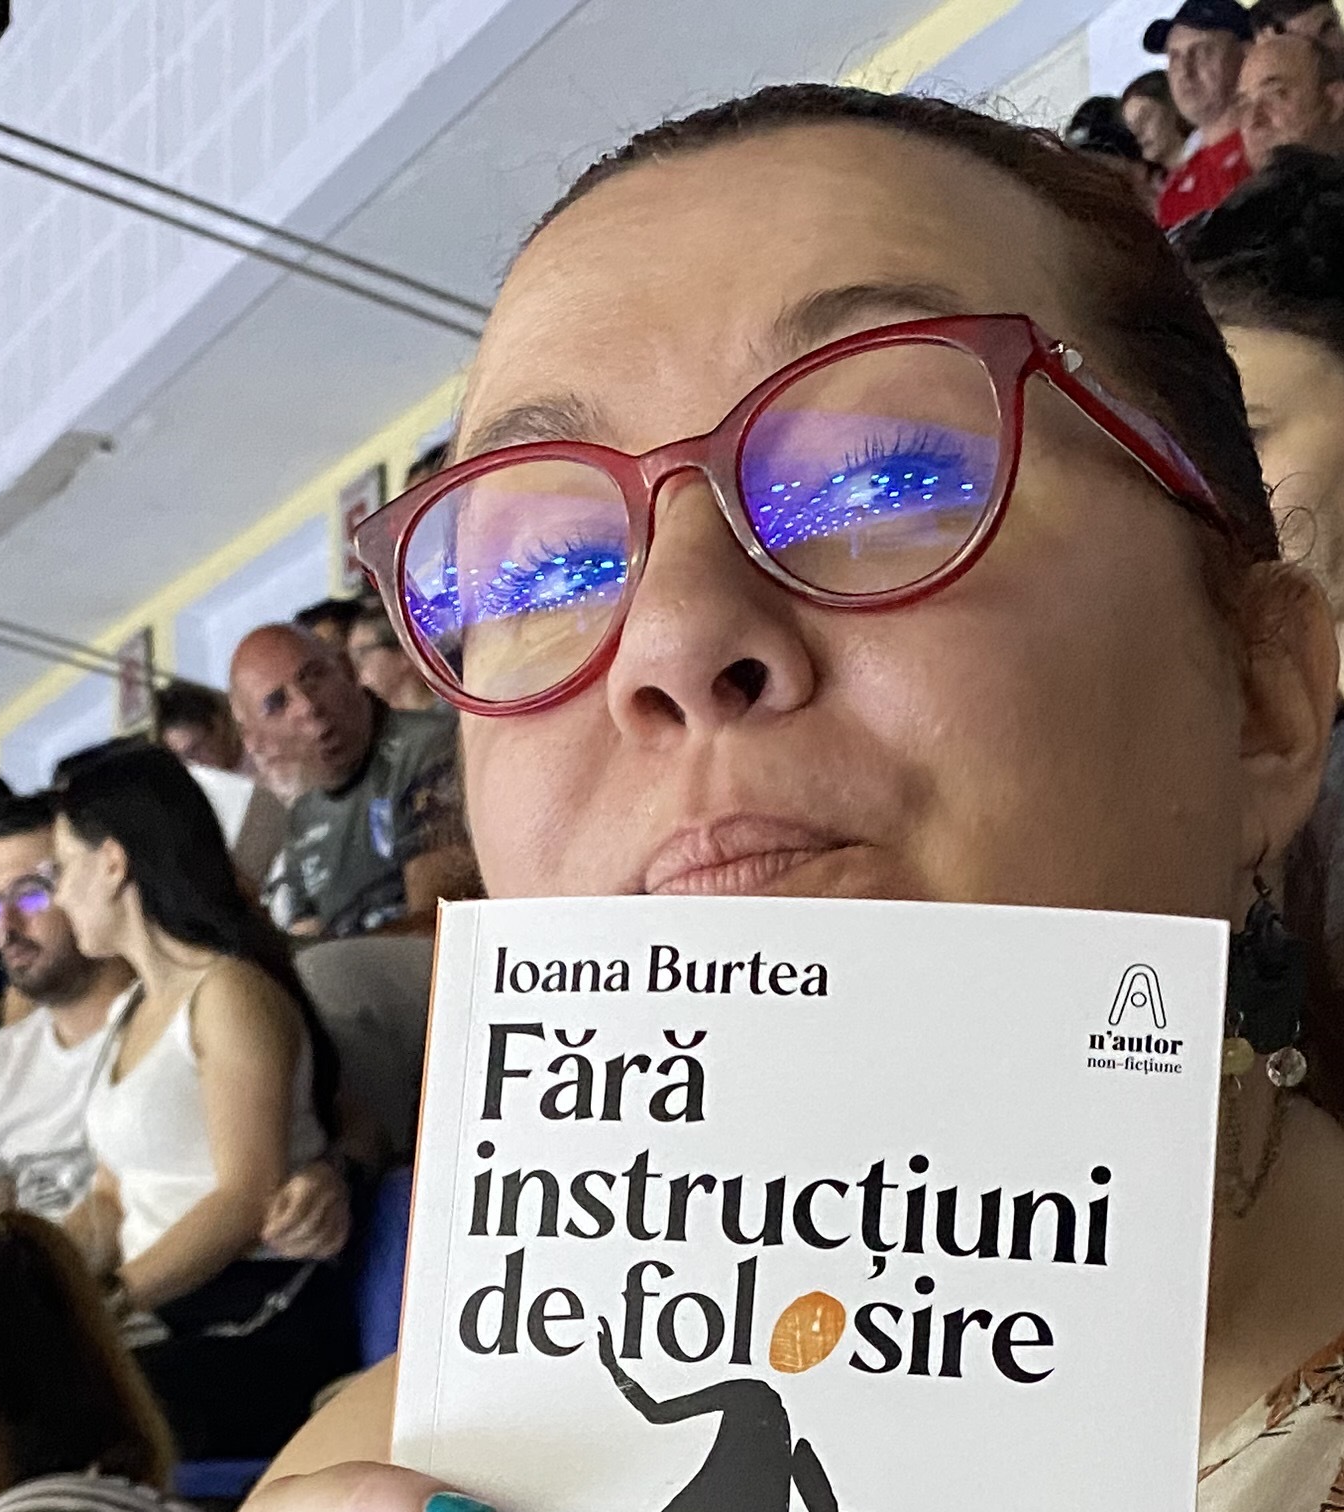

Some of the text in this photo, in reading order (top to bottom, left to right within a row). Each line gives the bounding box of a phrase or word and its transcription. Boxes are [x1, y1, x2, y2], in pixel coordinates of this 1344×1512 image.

[494, 945, 828, 997] Ioana Burtea
[481, 1022, 708, 1123] Fără
[467, 1140, 1112, 1280] instrucțiuni
[458, 1247, 585, 1357] de
